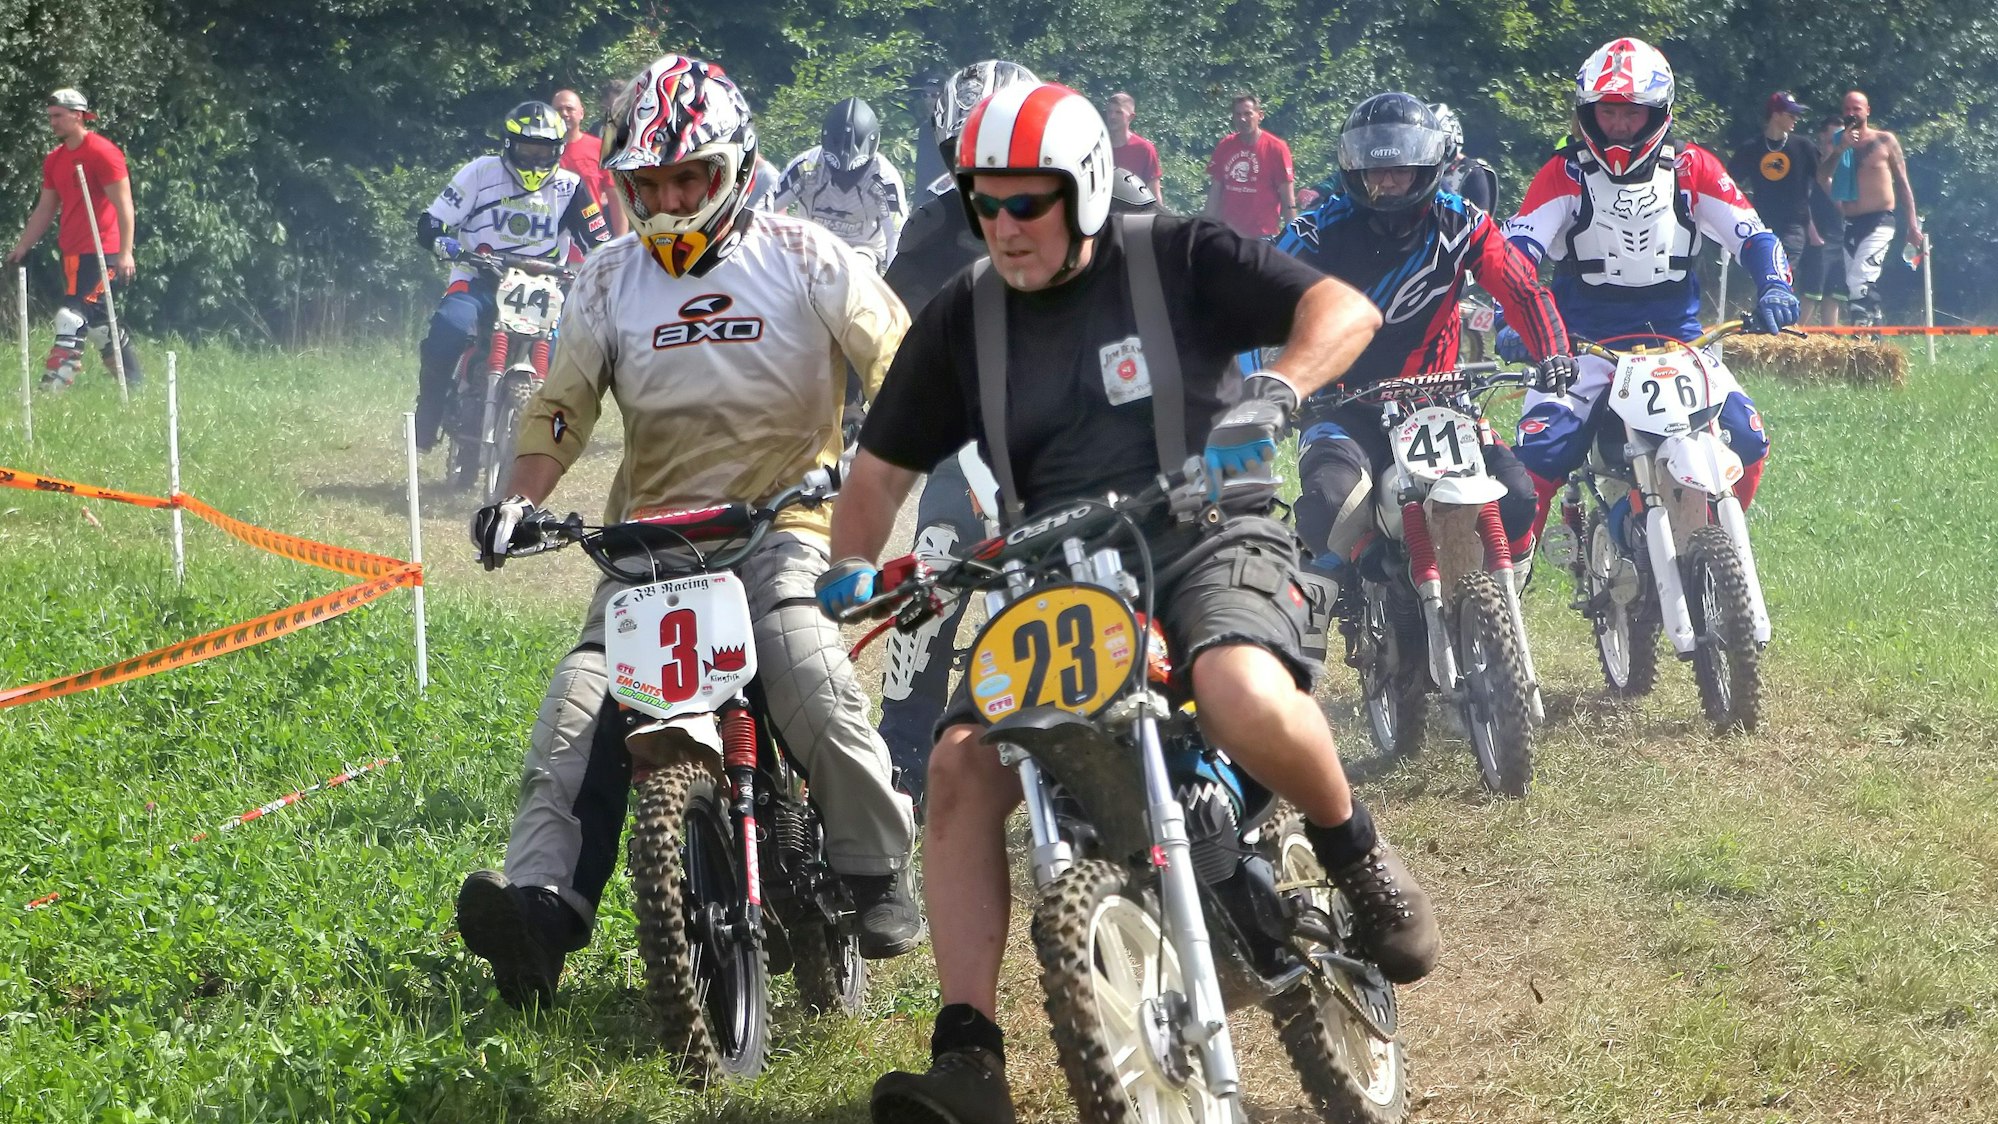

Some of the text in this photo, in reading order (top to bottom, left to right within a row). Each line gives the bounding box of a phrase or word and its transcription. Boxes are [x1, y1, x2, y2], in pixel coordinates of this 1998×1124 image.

[1473, 312, 1493, 329] 62
[1407, 421, 1463, 467] 41
[661, 578, 709, 594] Racing
[660, 608, 700, 703] 3
[1013, 604, 1099, 707] 23
[616, 675, 663, 697] EMONTS
